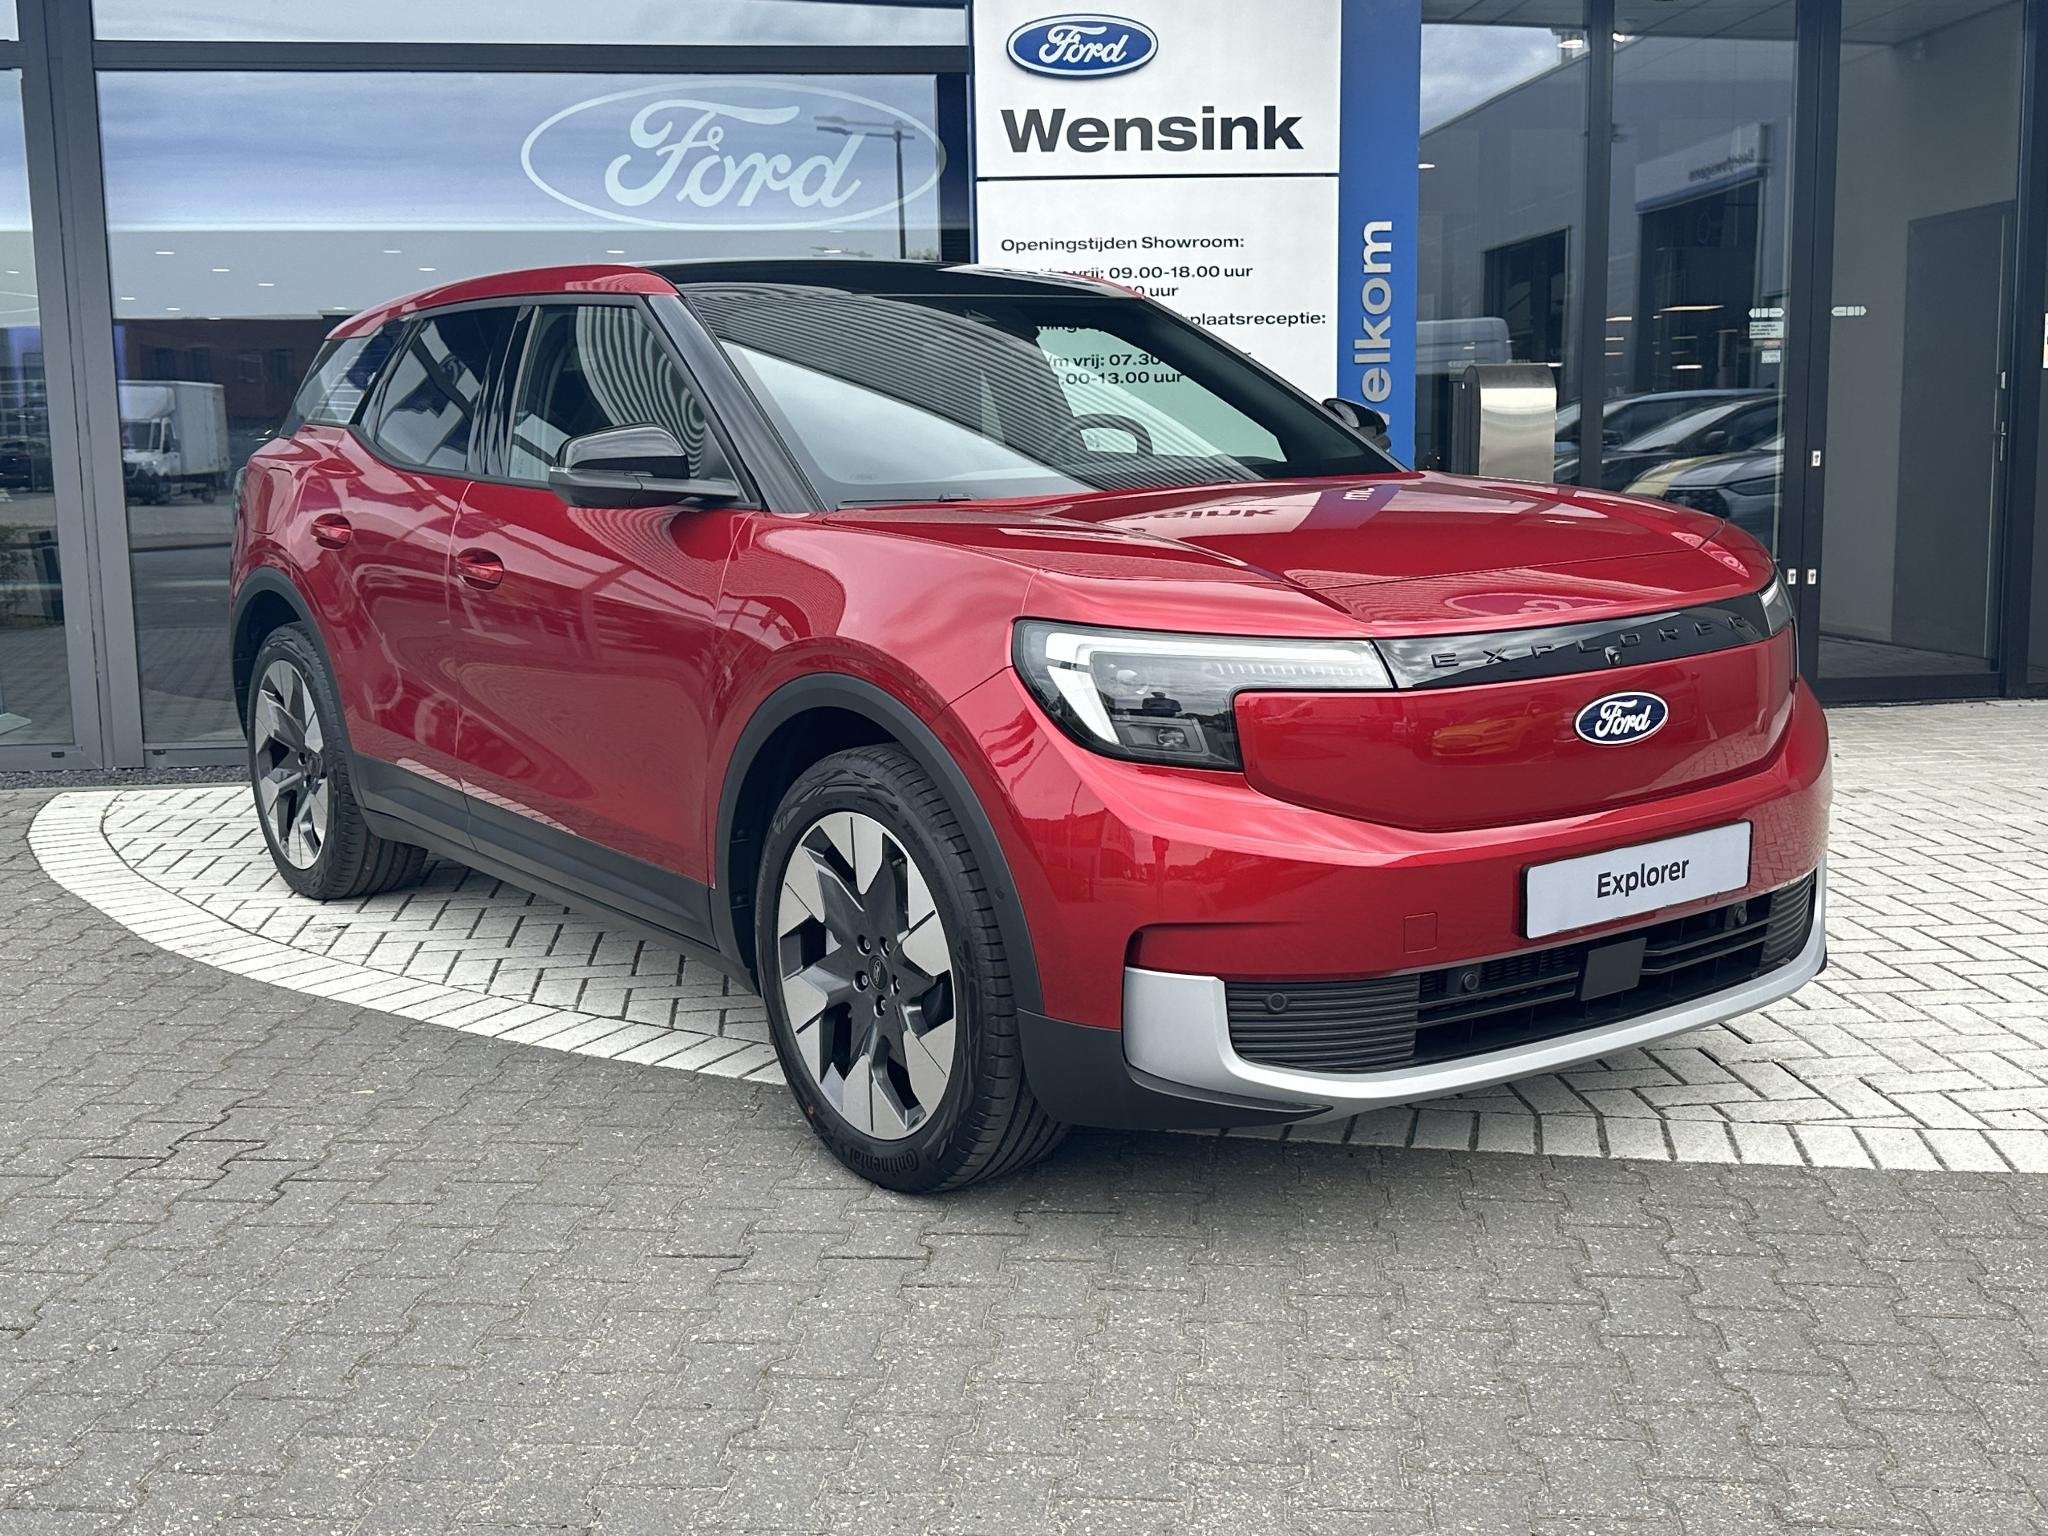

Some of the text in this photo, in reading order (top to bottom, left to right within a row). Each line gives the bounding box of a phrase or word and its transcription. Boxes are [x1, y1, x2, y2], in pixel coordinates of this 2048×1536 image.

[1037, 24, 1128, 64] Ford
[1000, 105, 1304, 153] Wensink
[604, 99, 862, 208] Ford
[1000, 236, 1245, 254] Openingstijden Showroom:
[1108, 265, 1220, 279] 09.00-18.00
[1224, 267, 1254, 278] uur
[1149, 286, 1179, 297] uur
[1183, 312, 1327, 327] plaatsreceptie:
[1353, 220, 1392, 425] elkom
[1056, 371, 1185, 385] .00-13.00 uur
[1073, 353, 1105, 369] vrij:
[1430, 615, 1748, 669] EXPLORER
[1594, 699, 1652, 739] Ford
[1596, 858, 1690, 899] Explorer
